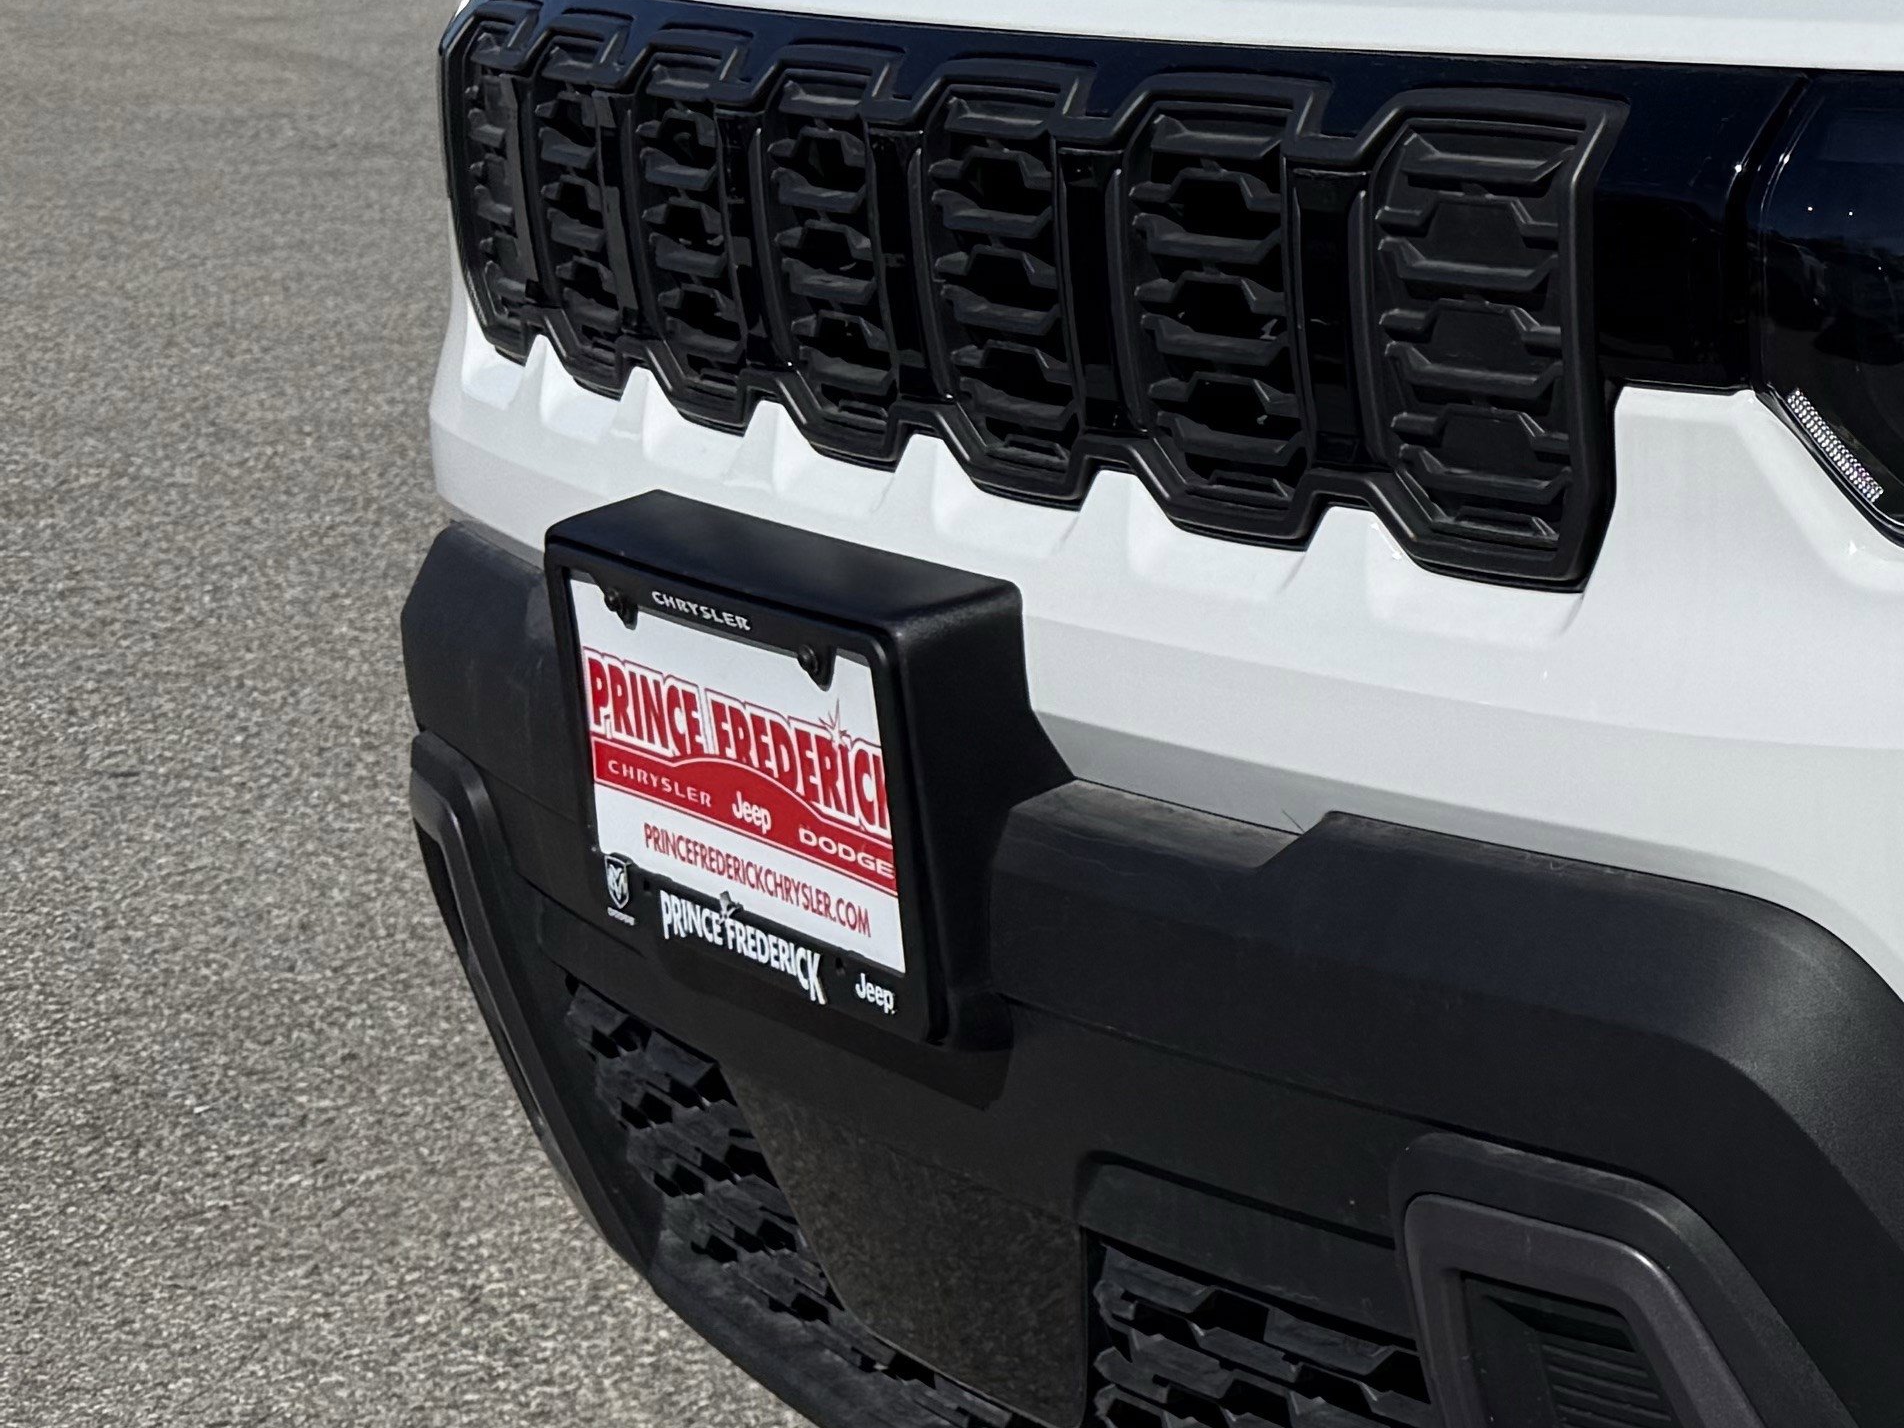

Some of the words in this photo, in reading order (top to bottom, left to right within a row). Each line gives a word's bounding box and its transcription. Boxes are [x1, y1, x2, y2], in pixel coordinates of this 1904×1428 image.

[652, 591, 751, 631] CHRYSLER
[587, 656, 705, 756] PRINCE
[607, 759, 712, 808] CHRYSLER
[732, 790, 772, 834] Jeep
[798, 827, 896, 879] DODGE
[643, 822, 871, 938] PRINCEFREDERICKCHRYSLER.COM
[659, 889, 724, 946] PRINCE
[726, 918, 827, 1005] FREDERICK
[855, 973, 896, 1014] Jeep
